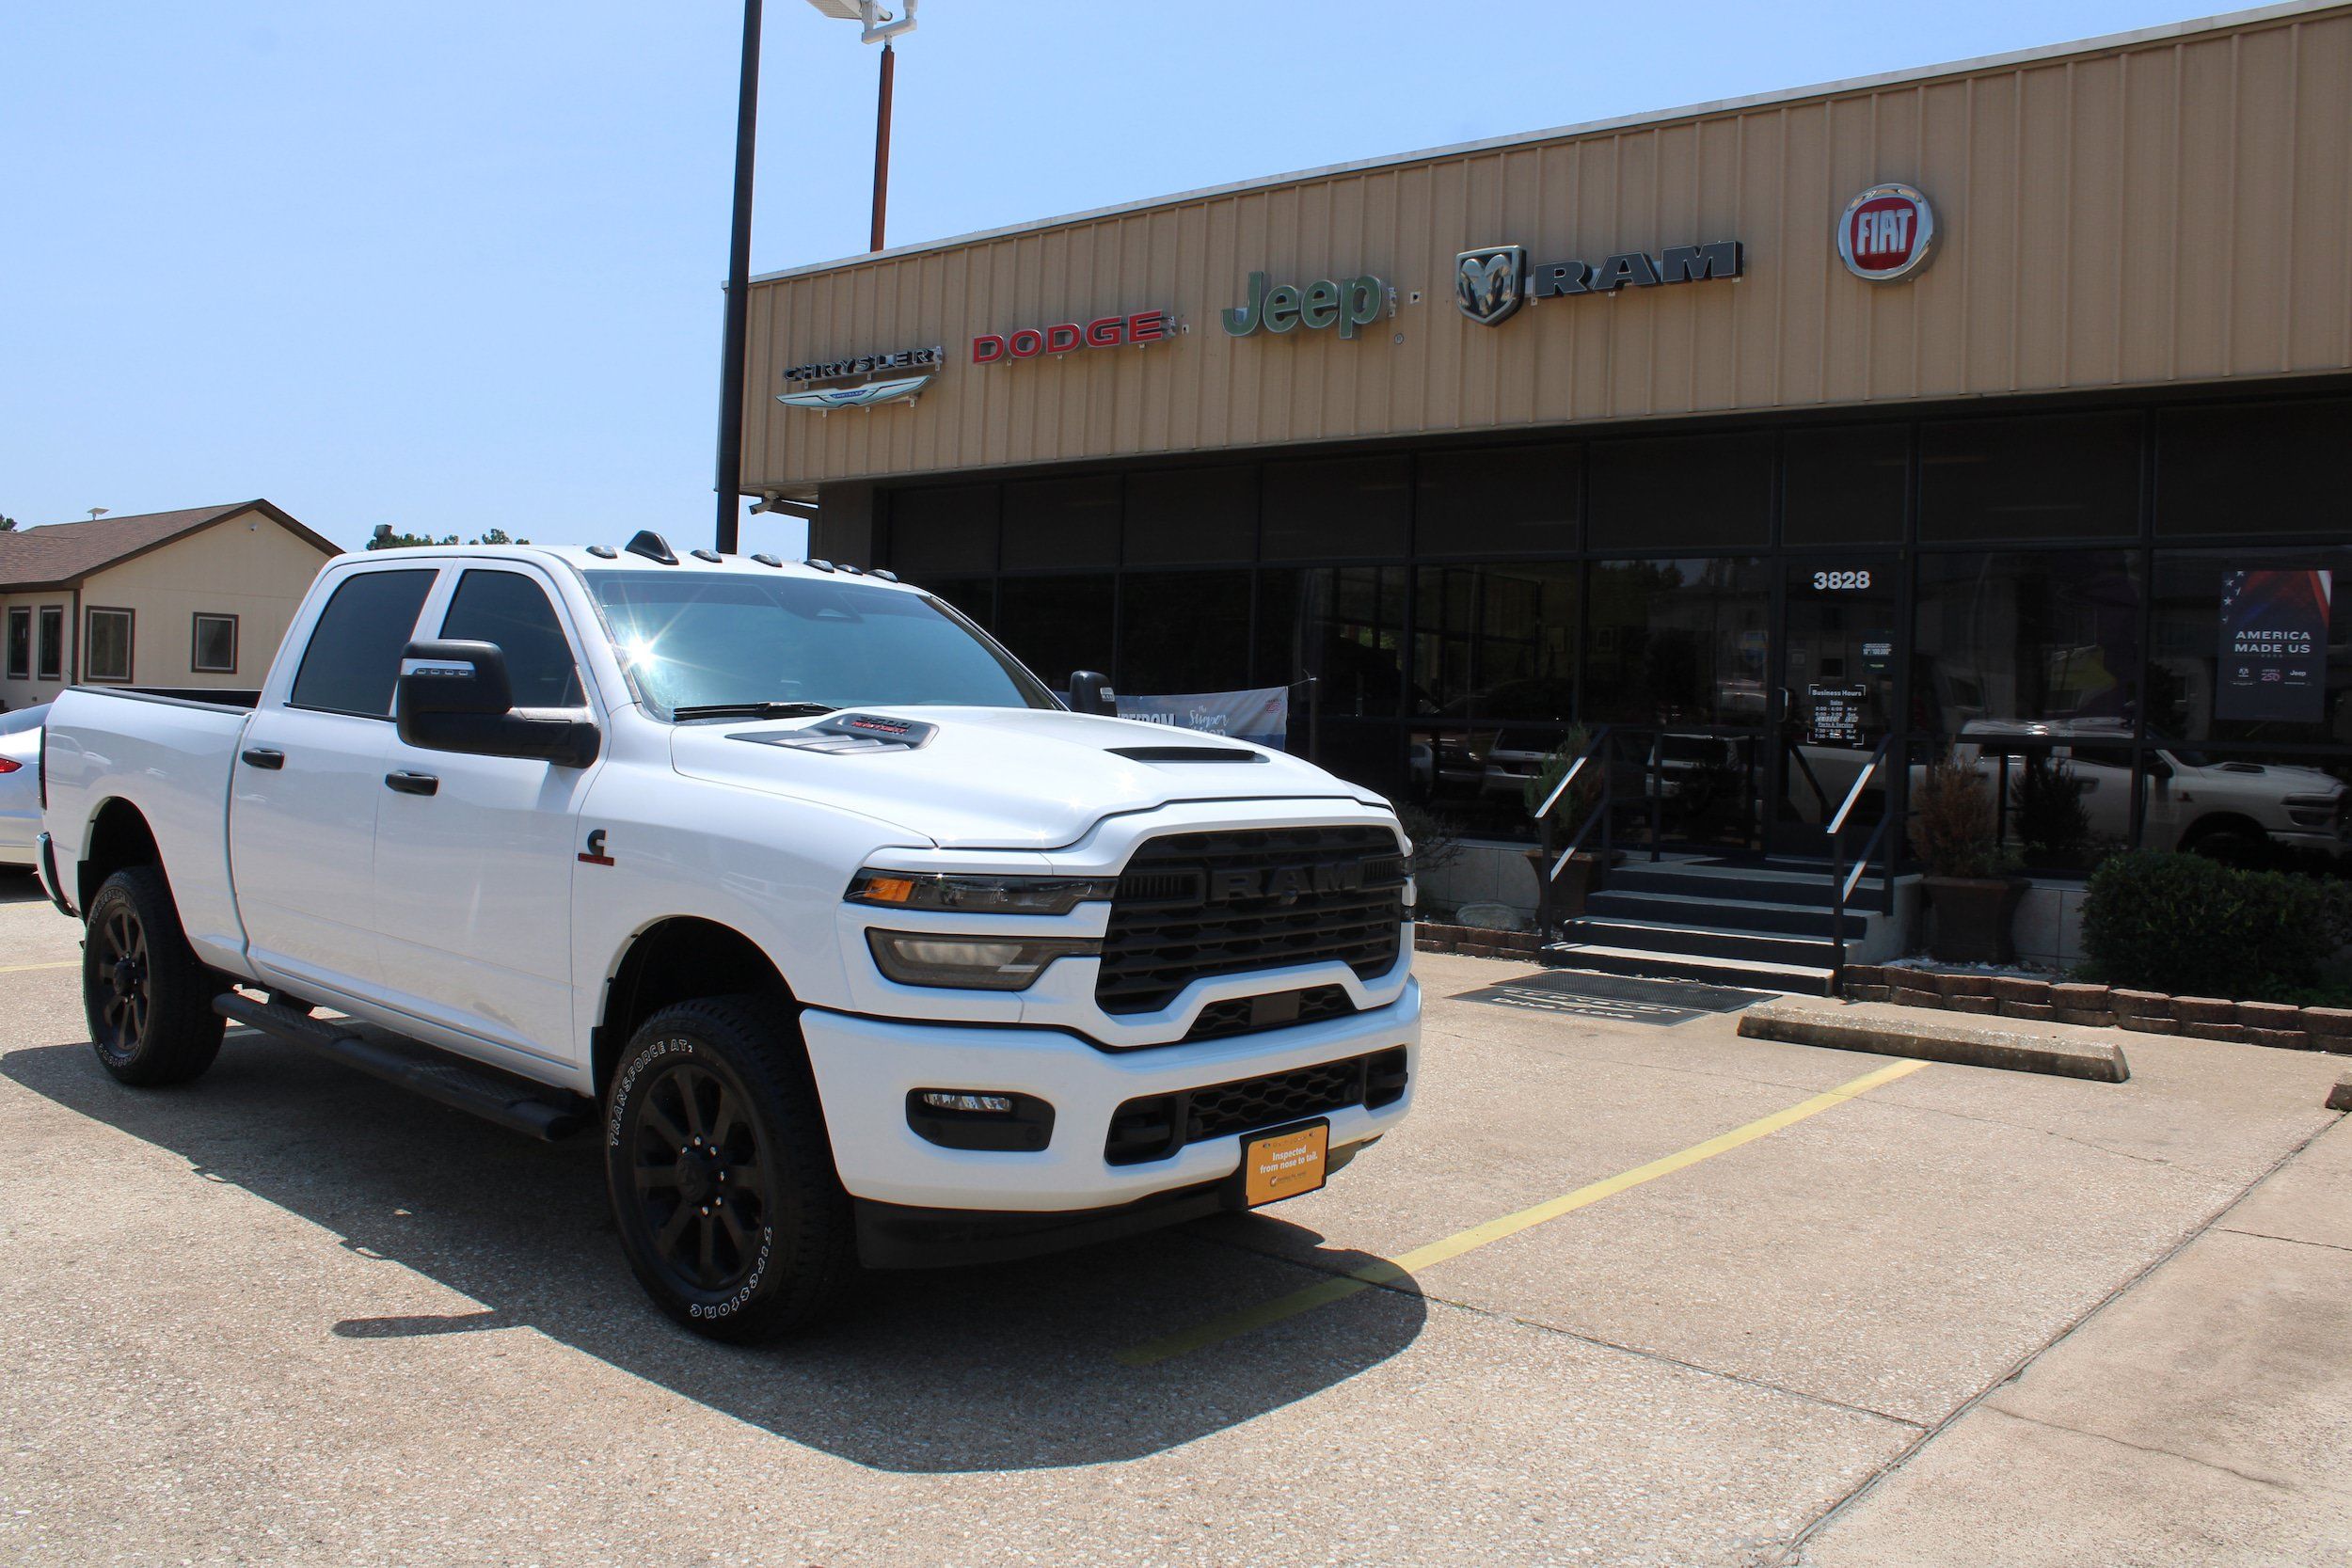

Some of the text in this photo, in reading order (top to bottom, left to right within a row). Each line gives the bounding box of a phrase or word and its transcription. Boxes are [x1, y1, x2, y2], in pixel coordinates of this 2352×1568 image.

[1856, 208, 1914, 256] FIAT
[1534, 240, 1739, 297] RAM
[1220, 270, 1382, 340] Jeep
[973, 309, 1163, 364] DODGE
[784, 348, 932, 382] CHRYSLER
[1813, 570, 1870, 590] 3828
[2234, 643, 2311, 653] MADE US
[2235, 630, 2312, 641] AMERICA
[1212, 861, 1361, 900] RAM
[610, 1041, 666, 1148] TRANSFORCE
[1260, 1150, 1318, 1174] from nose to tail.
[1272, 1144, 1307, 1162] Inspected
[690, 1227, 772, 1320] Firestone
